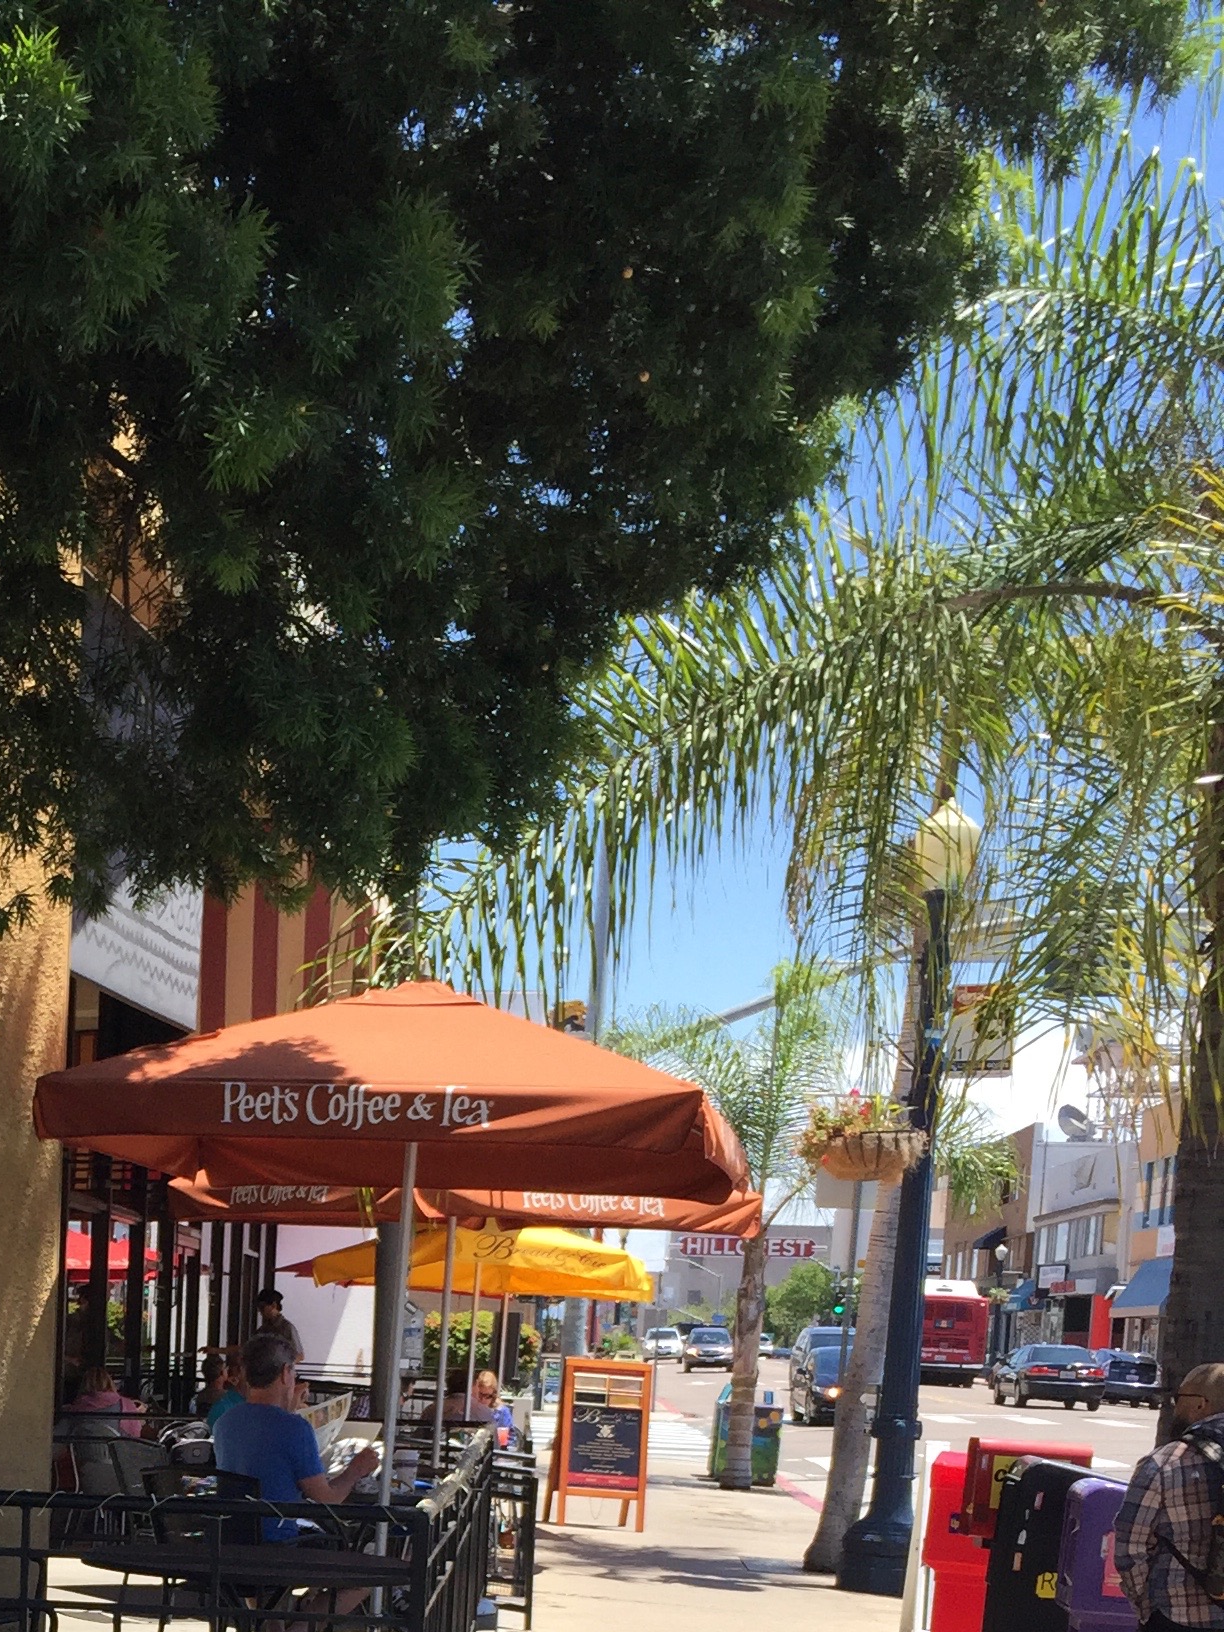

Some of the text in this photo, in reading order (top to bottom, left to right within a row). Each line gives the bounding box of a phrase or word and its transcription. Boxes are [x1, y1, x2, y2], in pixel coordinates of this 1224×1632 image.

[220, 1081, 300, 1125] Peet's
[305, 1082, 402, 1131] Coffee
[405, 1093, 437, 1121] &
[229, 1185, 260, 1205] Peets
[522, 1191, 565, 1210] Peets
[686, 1237, 811, 1257] HILLCEST
